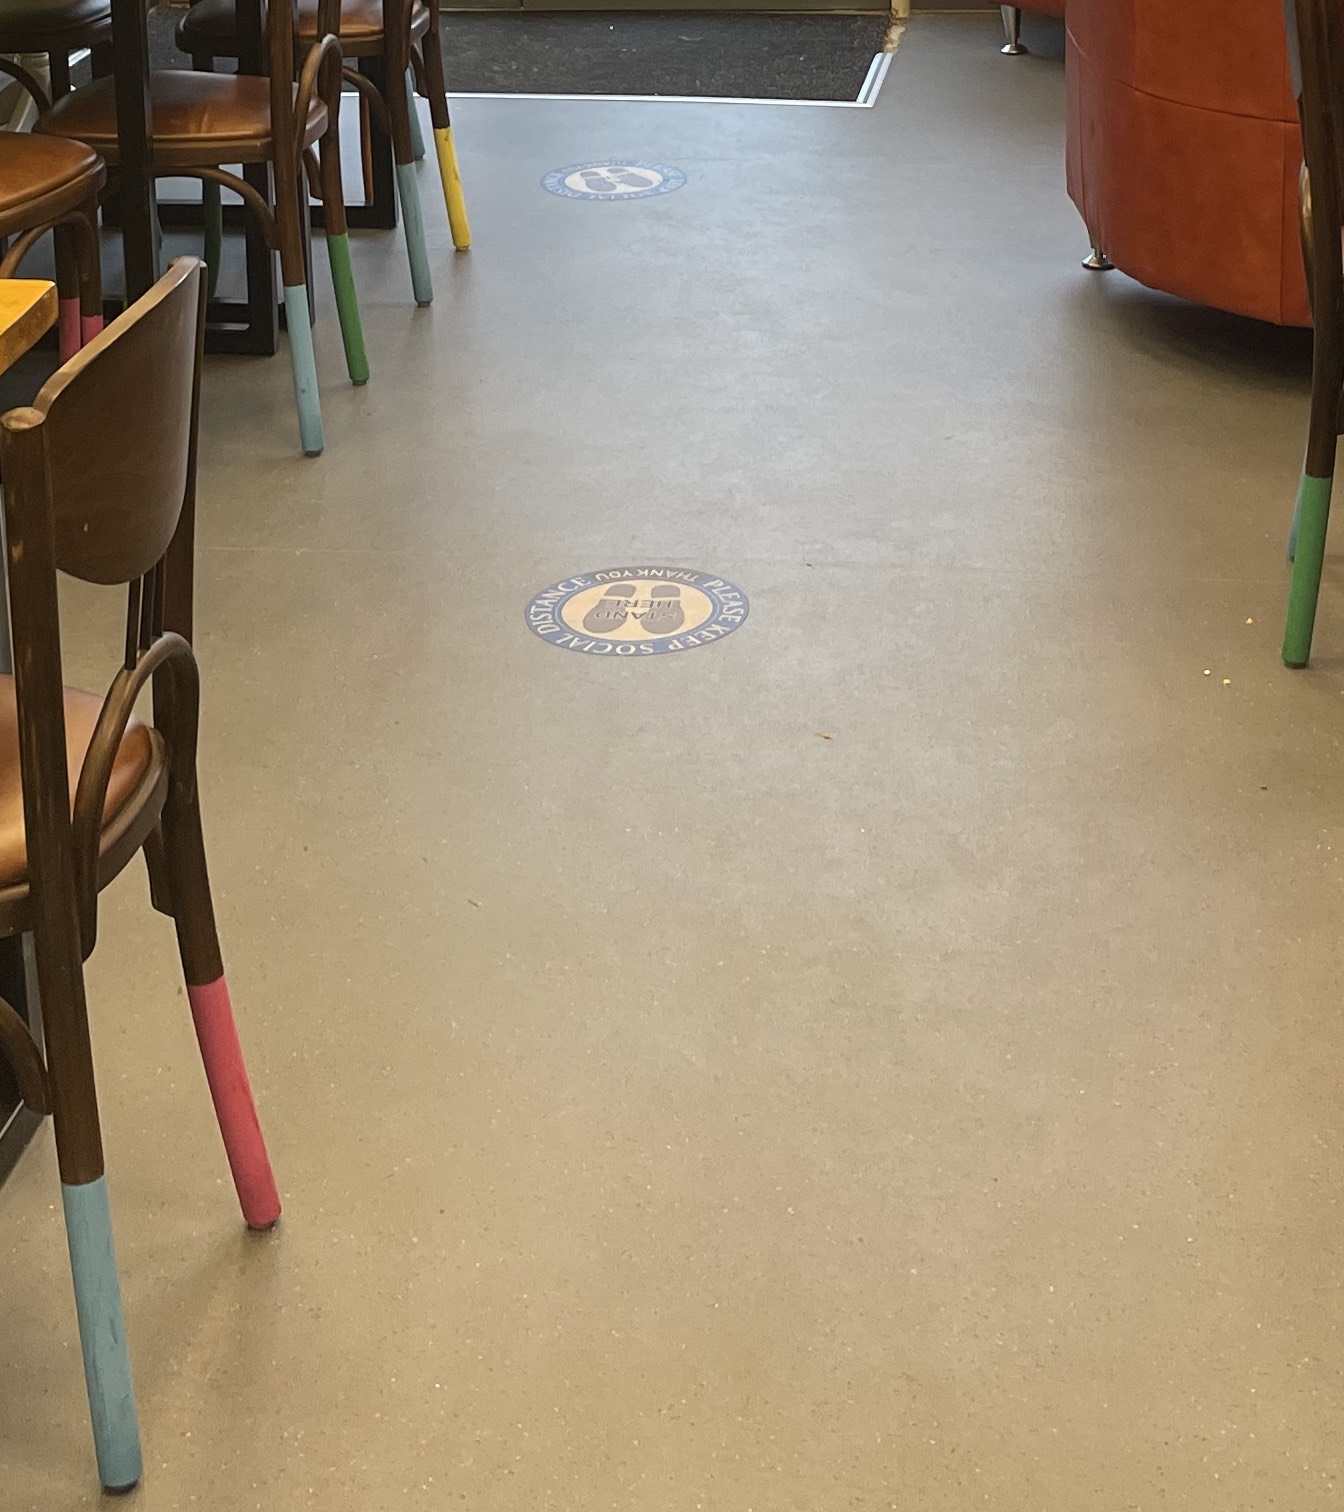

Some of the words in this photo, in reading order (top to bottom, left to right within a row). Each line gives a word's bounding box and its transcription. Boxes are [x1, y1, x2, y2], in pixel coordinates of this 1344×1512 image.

[595, 569, 633, 582] YOU
[636, 567, 699, 582] THANK
[527, 576, 592, 635] DISTANCE
[611, 599, 676, 609] HERE
[703, 579, 745, 623] PLEASE
[594, 610, 678, 621] STAND
[556, 632, 655, 655] SOCIAL
[668, 623, 731, 652] KEEP
